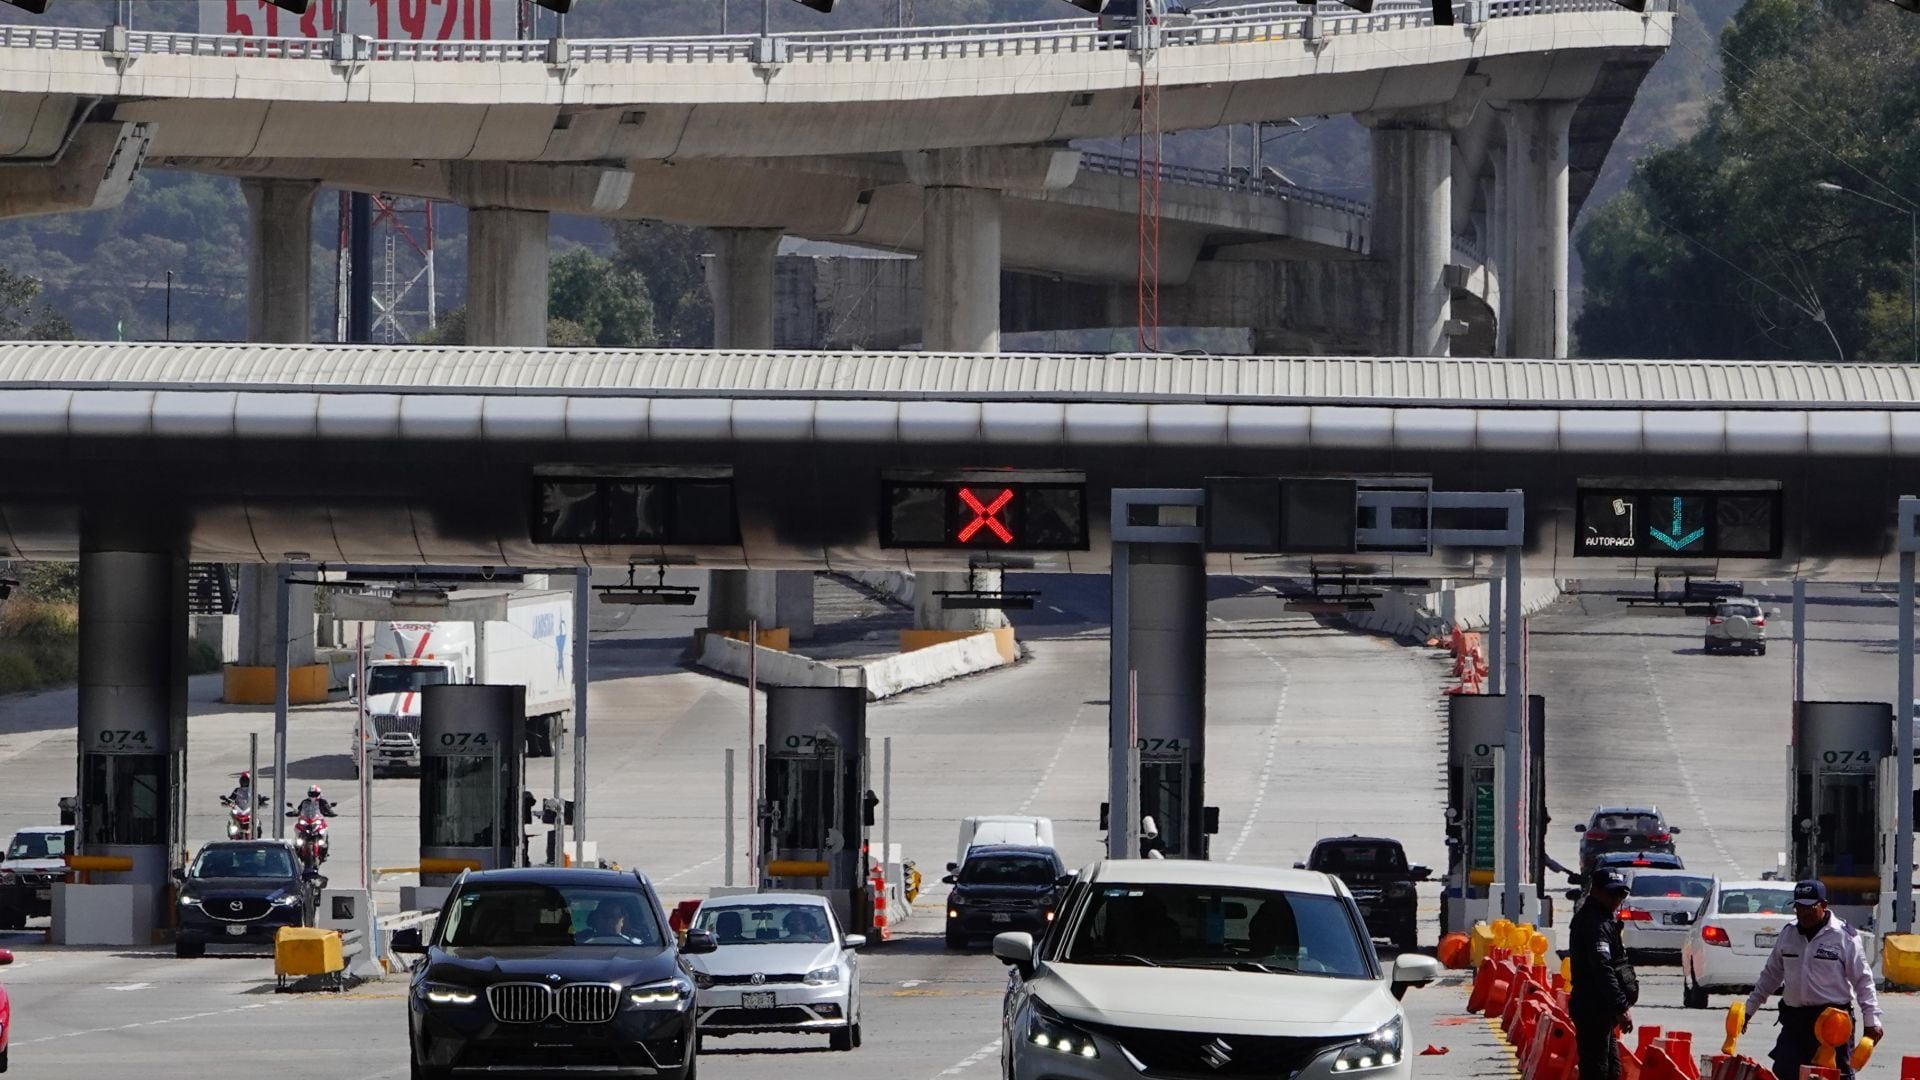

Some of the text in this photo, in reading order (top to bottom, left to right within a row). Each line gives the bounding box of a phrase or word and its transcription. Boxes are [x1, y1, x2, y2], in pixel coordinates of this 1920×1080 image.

[369, 0, 491, 61] 1920
[1585, 537, 1635, 547] AUTOPAGO
[100, 729, 148, 744] 074
[440, 732, 489, 746] 074
[785, 734, 821, 748] 07
[1137, 737, 1181, 751] 074
[1822, 750, 1872, 764] 074
